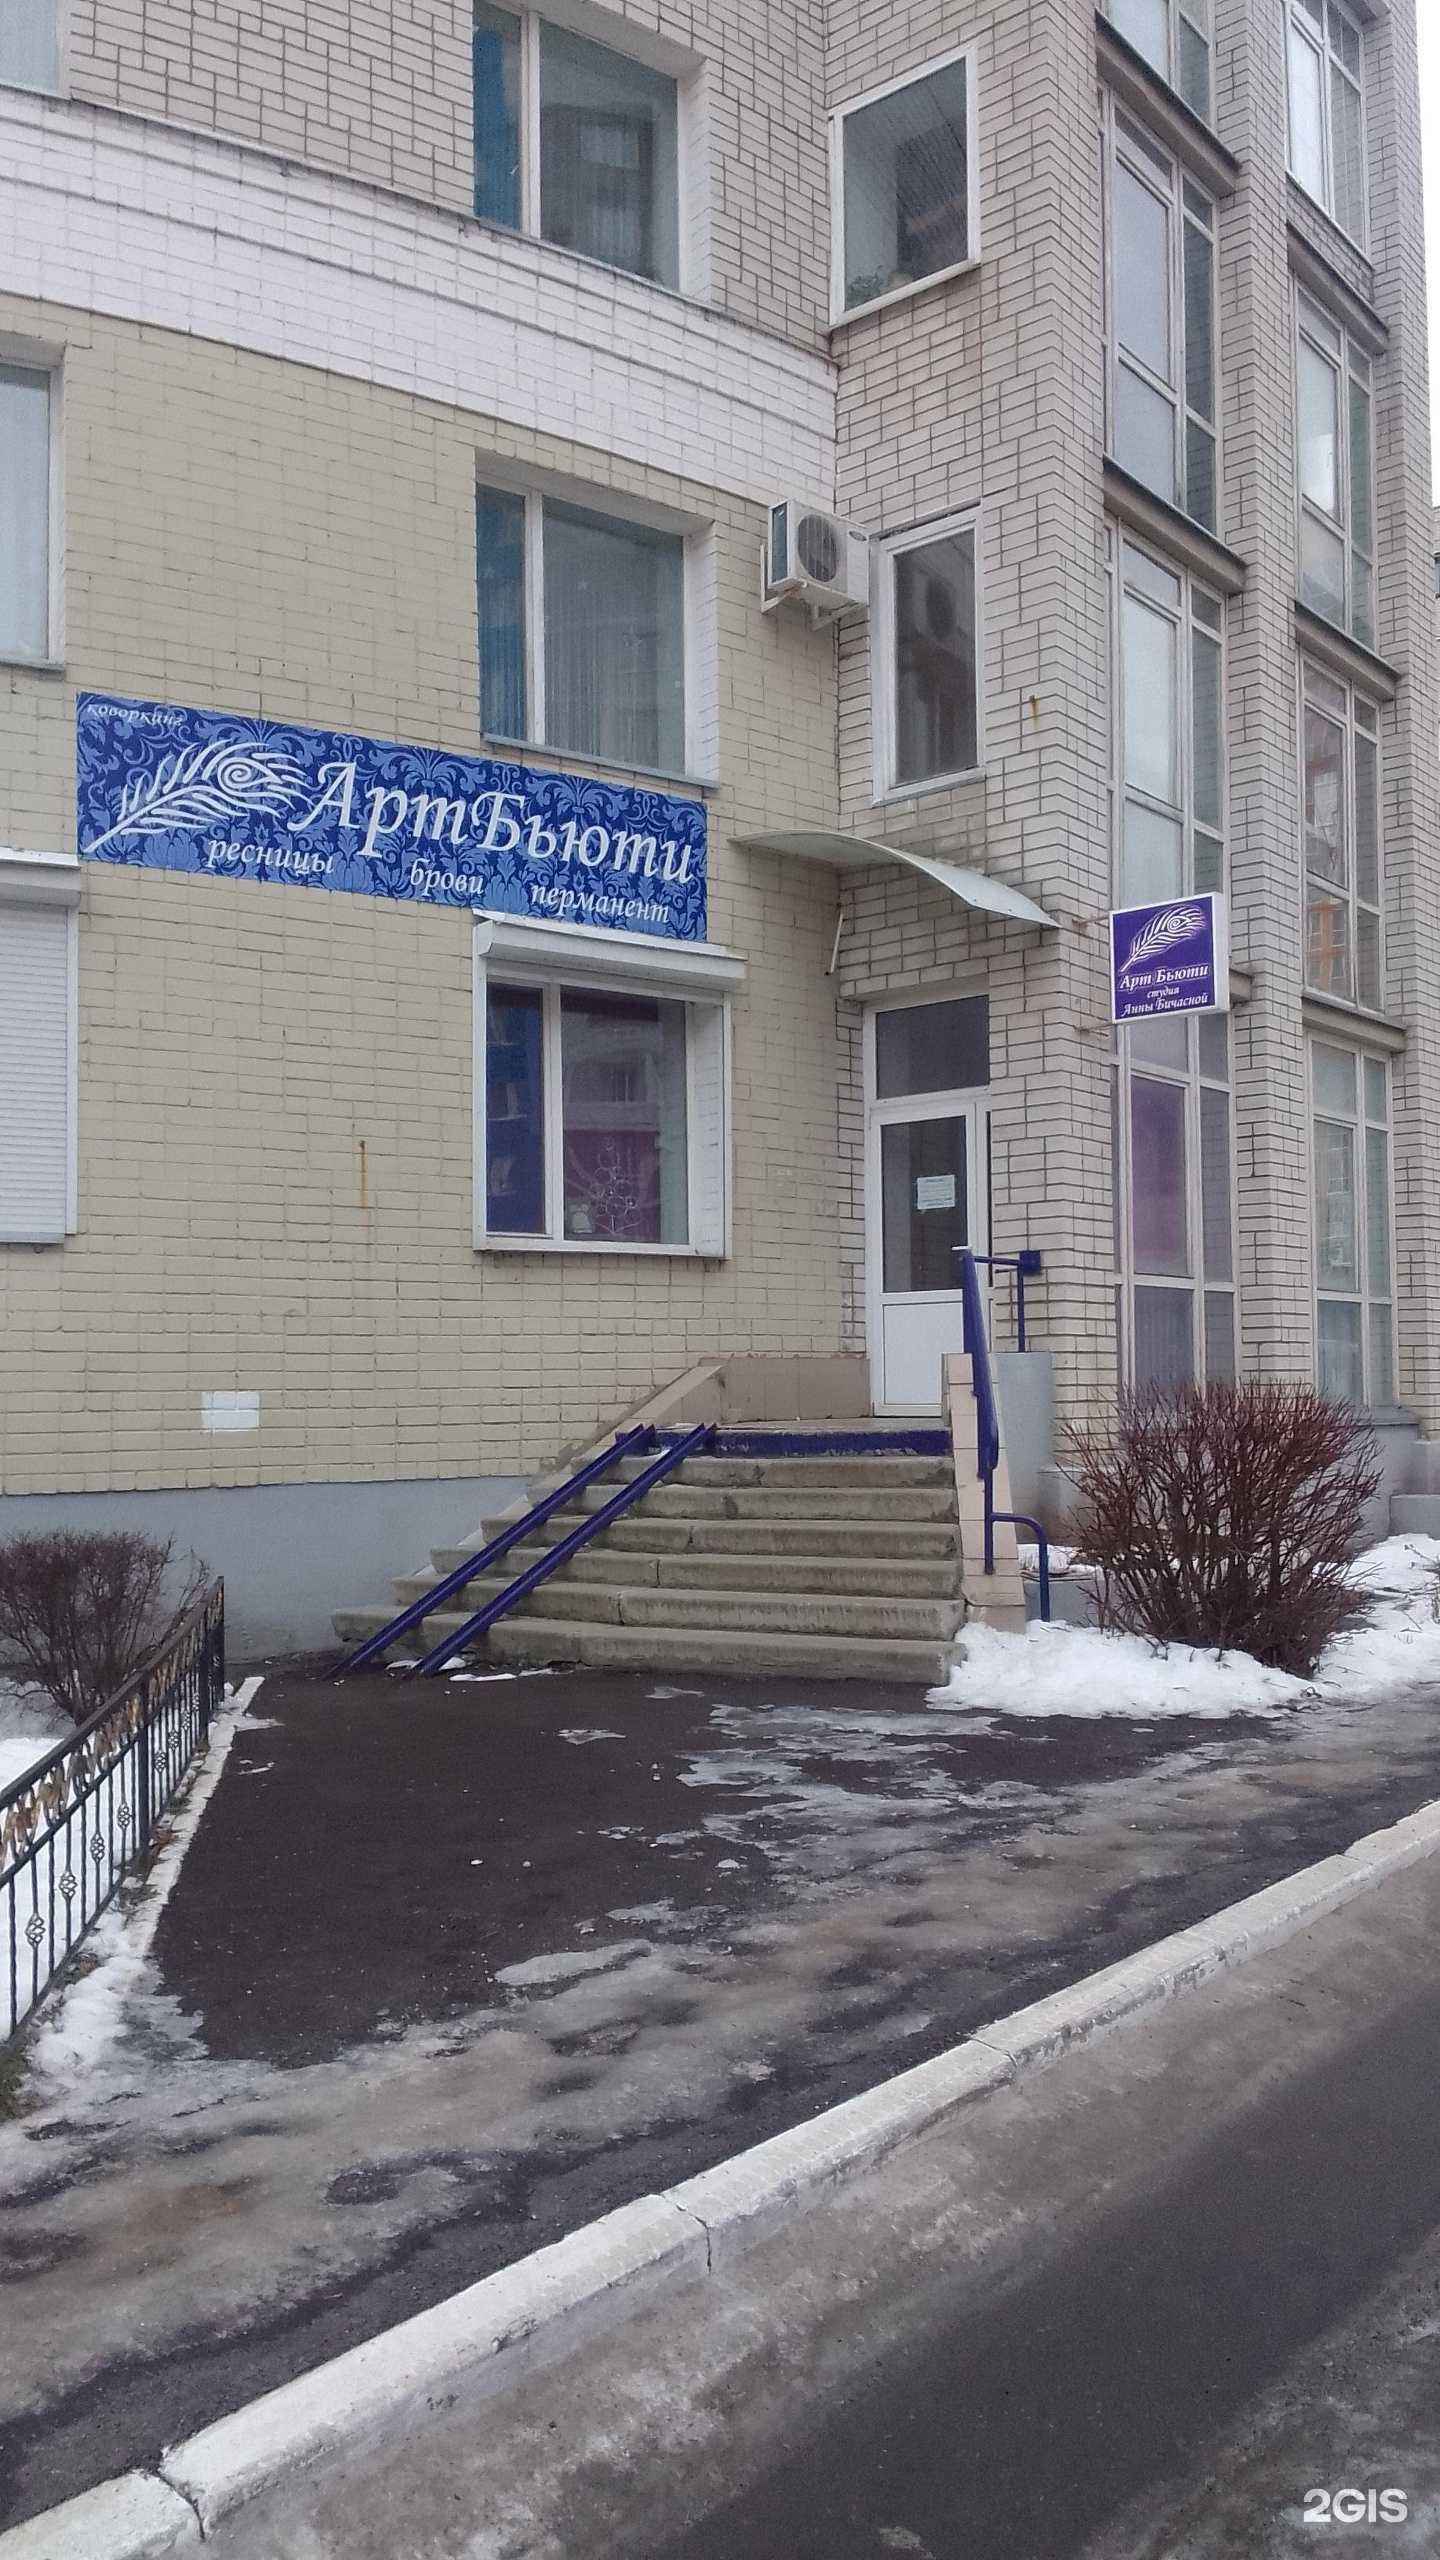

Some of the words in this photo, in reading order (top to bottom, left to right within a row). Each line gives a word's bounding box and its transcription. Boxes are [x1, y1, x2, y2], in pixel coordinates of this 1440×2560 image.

[86, 703, 183, 727] коворкинг
[286, 761, 694, 884] АртБьюти
[207, 838, 334, 876] ресницы
[410, 858, 484, 898] брови
[531, 883, 670, 924] перманент
[1119, 974, 1152, 992] Арт
[1156, 965, 1209, 983] Бьюти
[1146, 985, 1180, 999] студия
[1121, 1003, 1154, 1017] Анны
